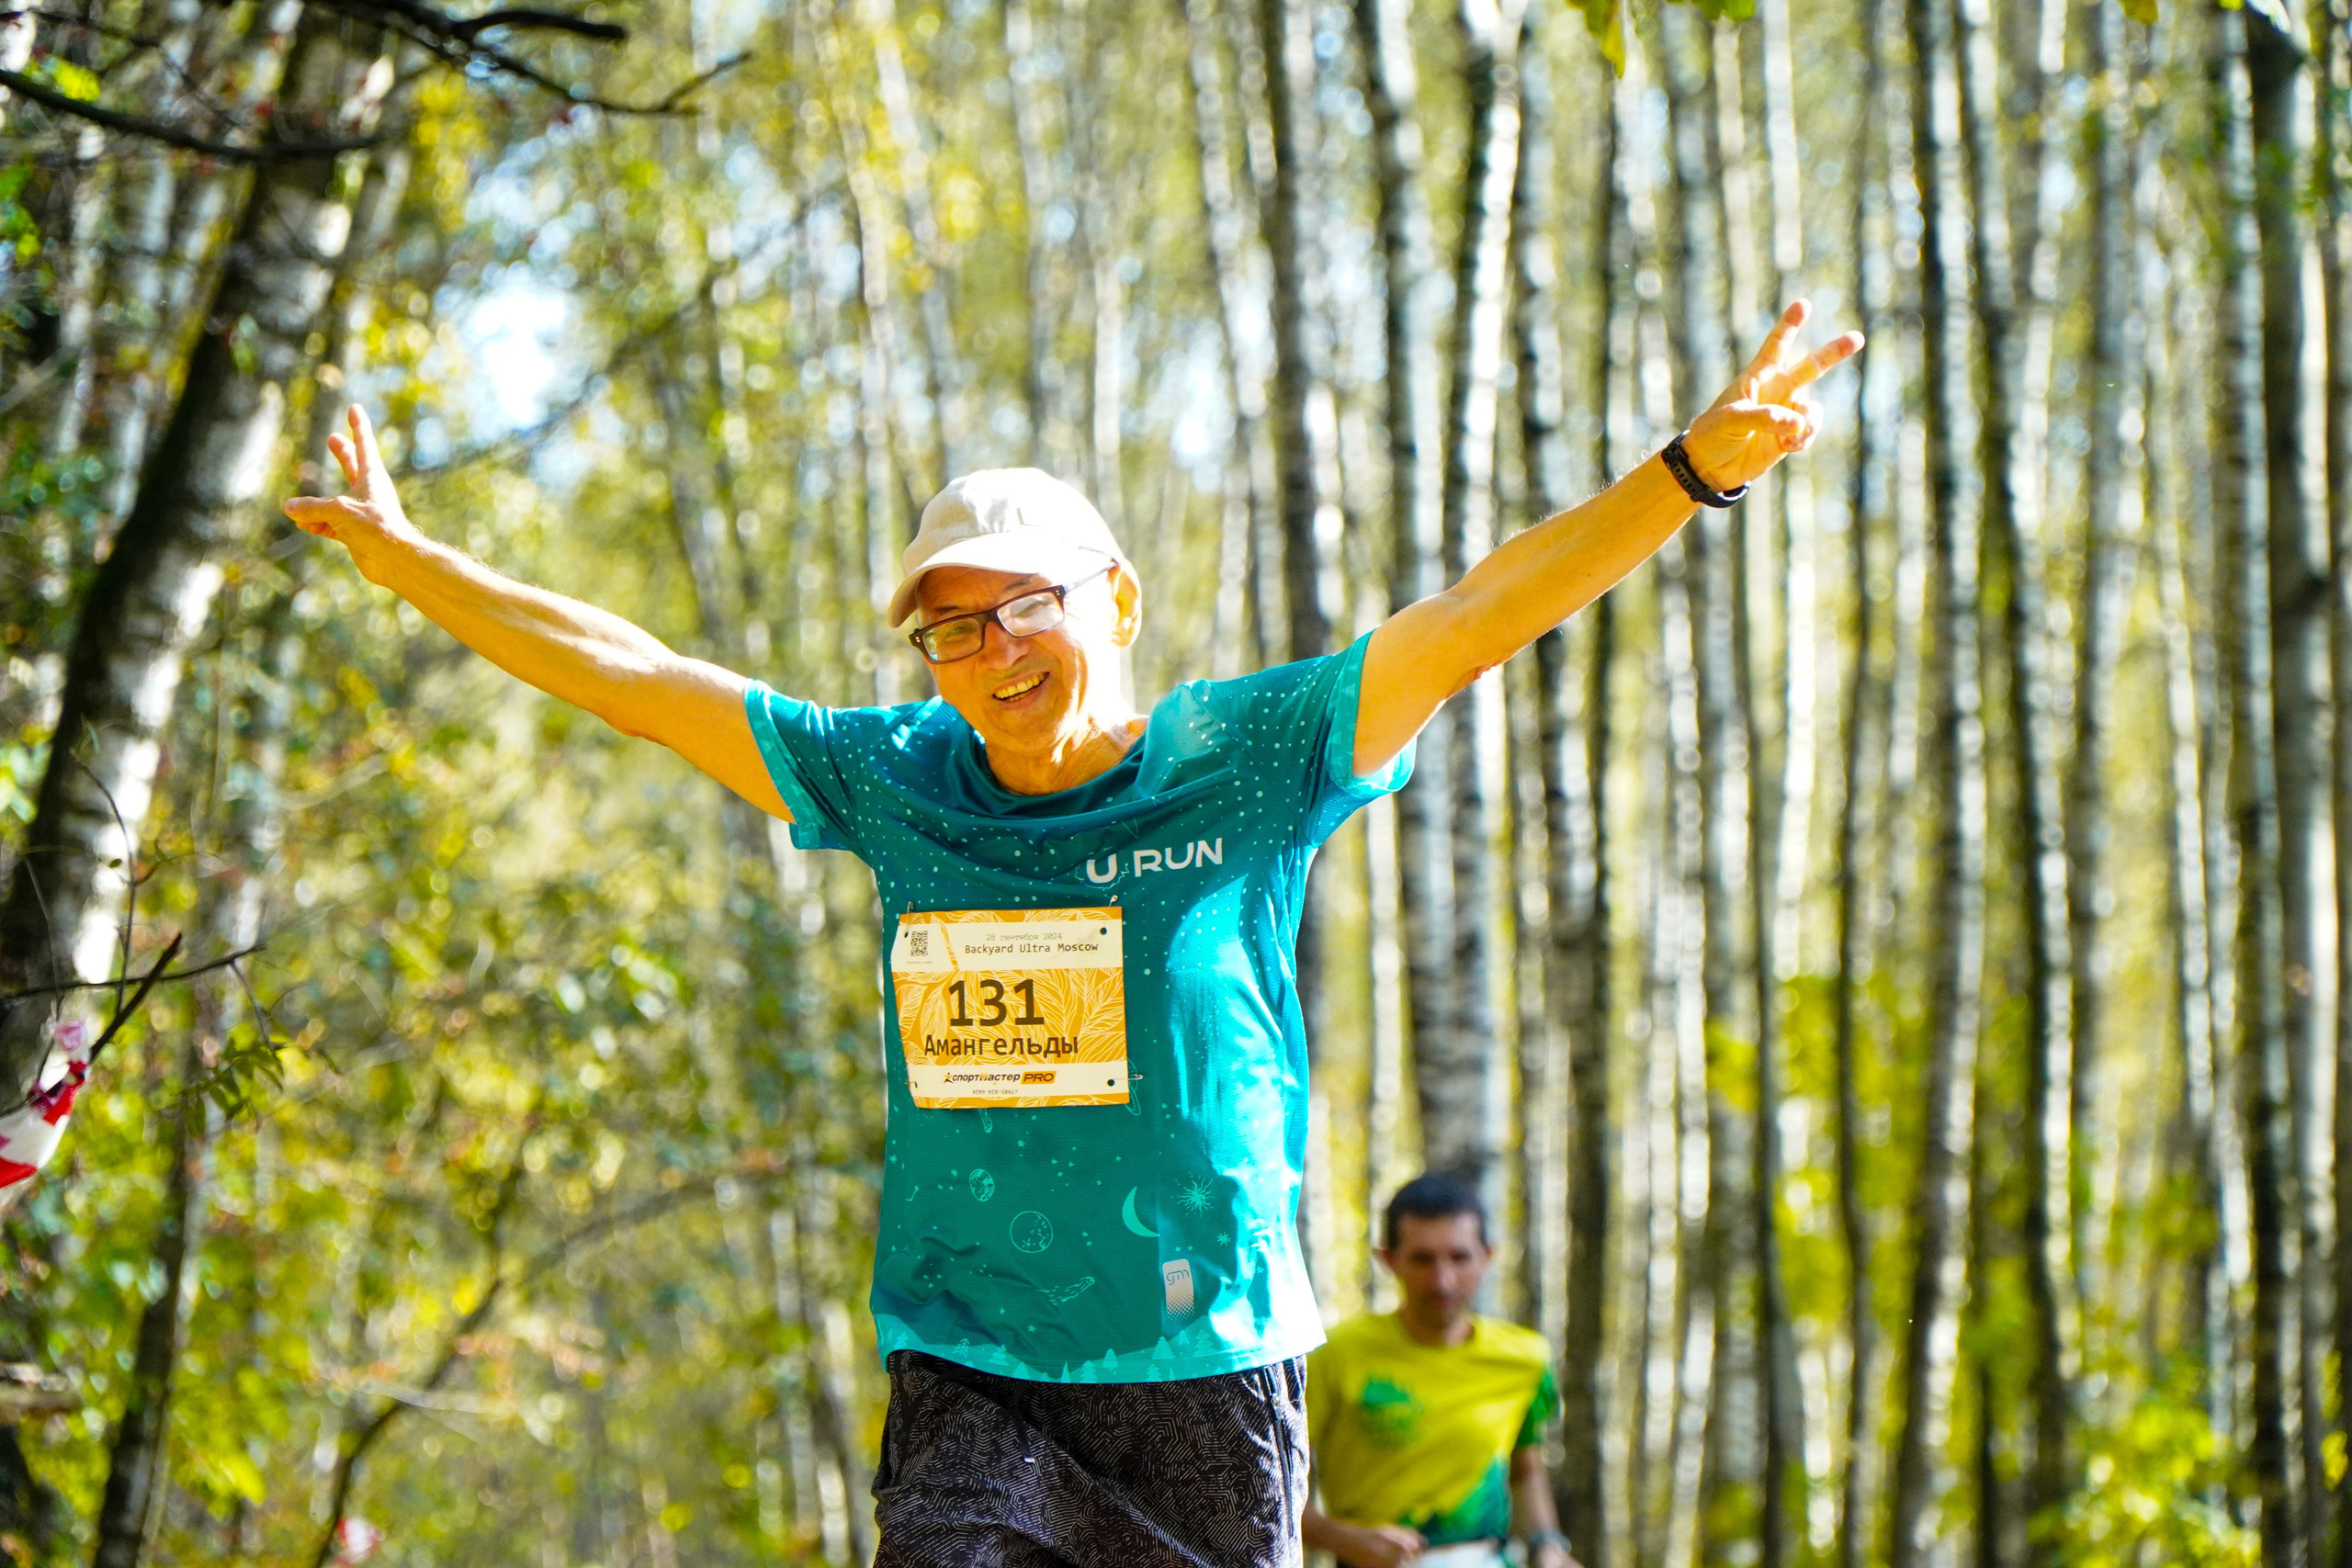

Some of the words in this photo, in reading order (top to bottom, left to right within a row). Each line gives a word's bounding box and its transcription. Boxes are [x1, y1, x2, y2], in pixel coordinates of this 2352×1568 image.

[1086, 853, 1118, 884] U
[1133, 838, 1223, 877] RUN
[986, 933, 996, 942] 28
[1000, 933, 1039, 942] сентября
[1043, 932, 1062, 941] 2024
[965, 942, 1013, 956] Backyard
[1020, 942, 1051, 953] Ultra
[1057, 942, 1098, 953] Moscow
[948, 978, 1045, 1027] 131
[924, 1034, 1079, 1058] Амангельды
[1023, 1072, 1054, 1083] PRO
